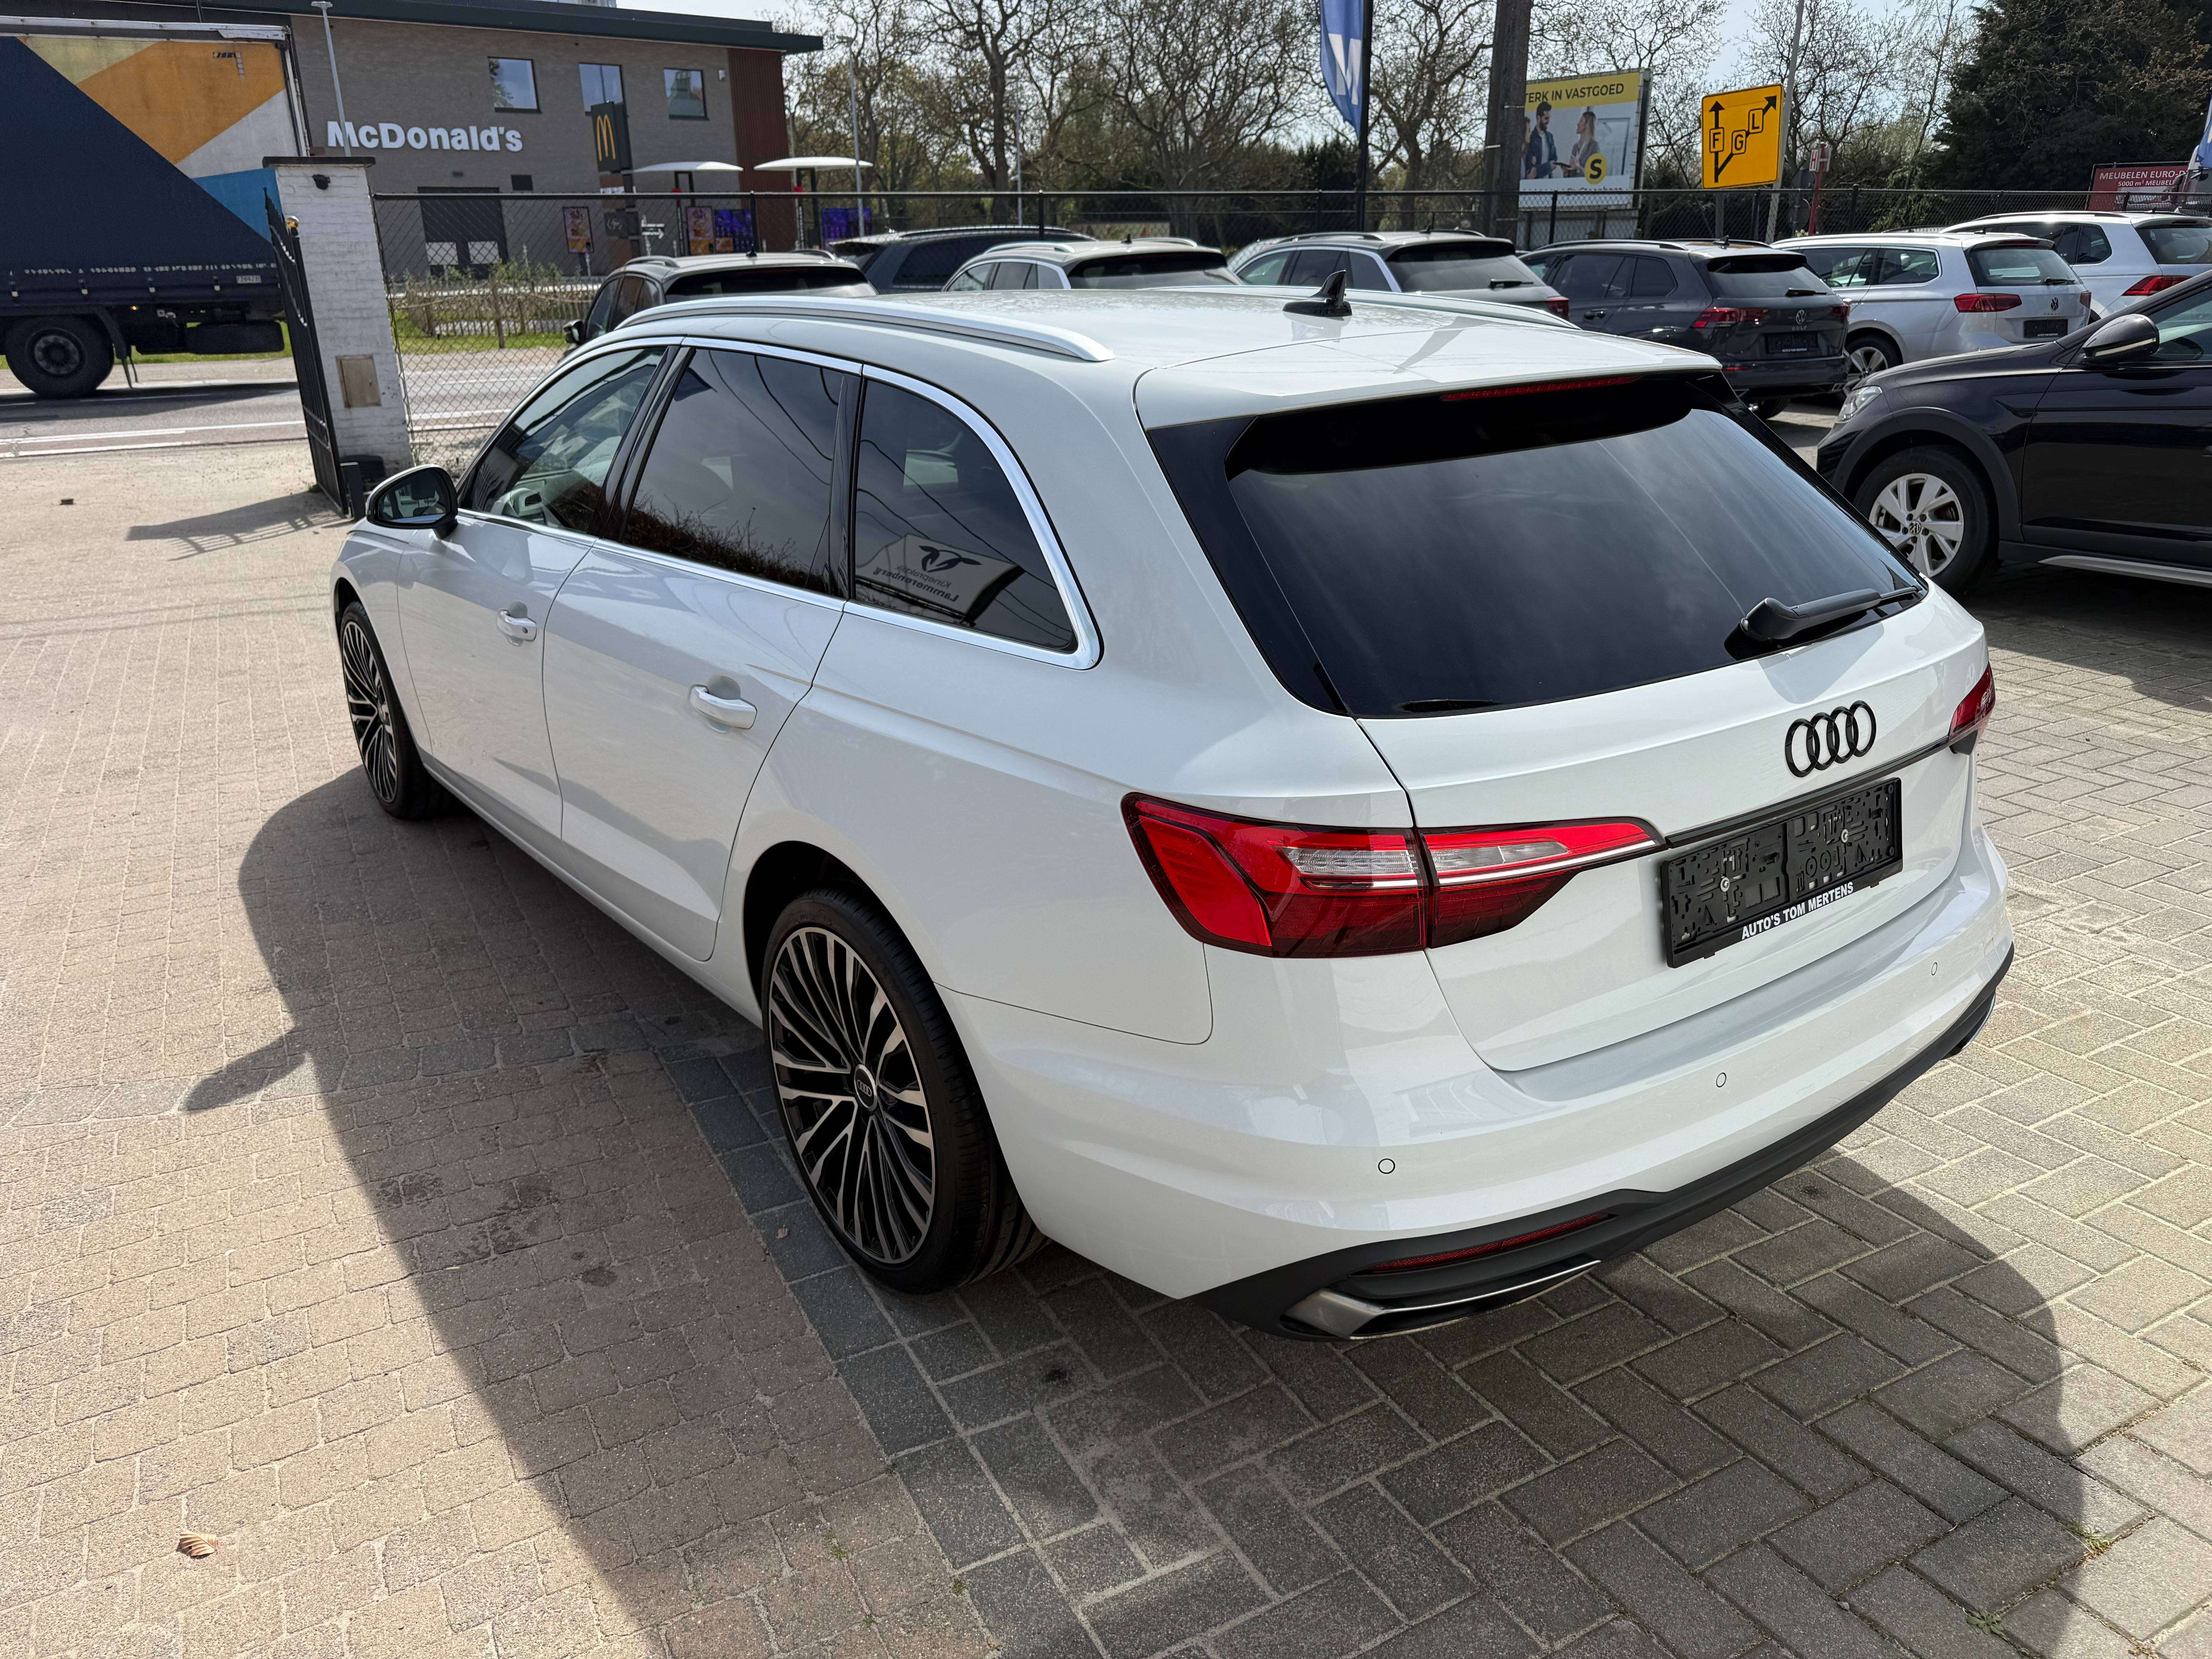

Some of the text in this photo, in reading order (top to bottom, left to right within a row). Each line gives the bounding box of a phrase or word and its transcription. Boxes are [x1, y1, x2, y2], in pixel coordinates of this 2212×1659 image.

[1551, 89, 1562, 101] IN
[1565, 83, 1625, 99] VASTGOED
[1752, 113, 1760, 130] L
[327, 121, 523, 152] McDonald's
[1713, 132, 1721, 148] F
[1735, 134, 1744, 151] G
[1590, 159, 1602, 179] S
[2100, 171, 2147, 179] MEUBELEN
[1741, 881, 1854, 940] AUTO'S TOM MERTENS
